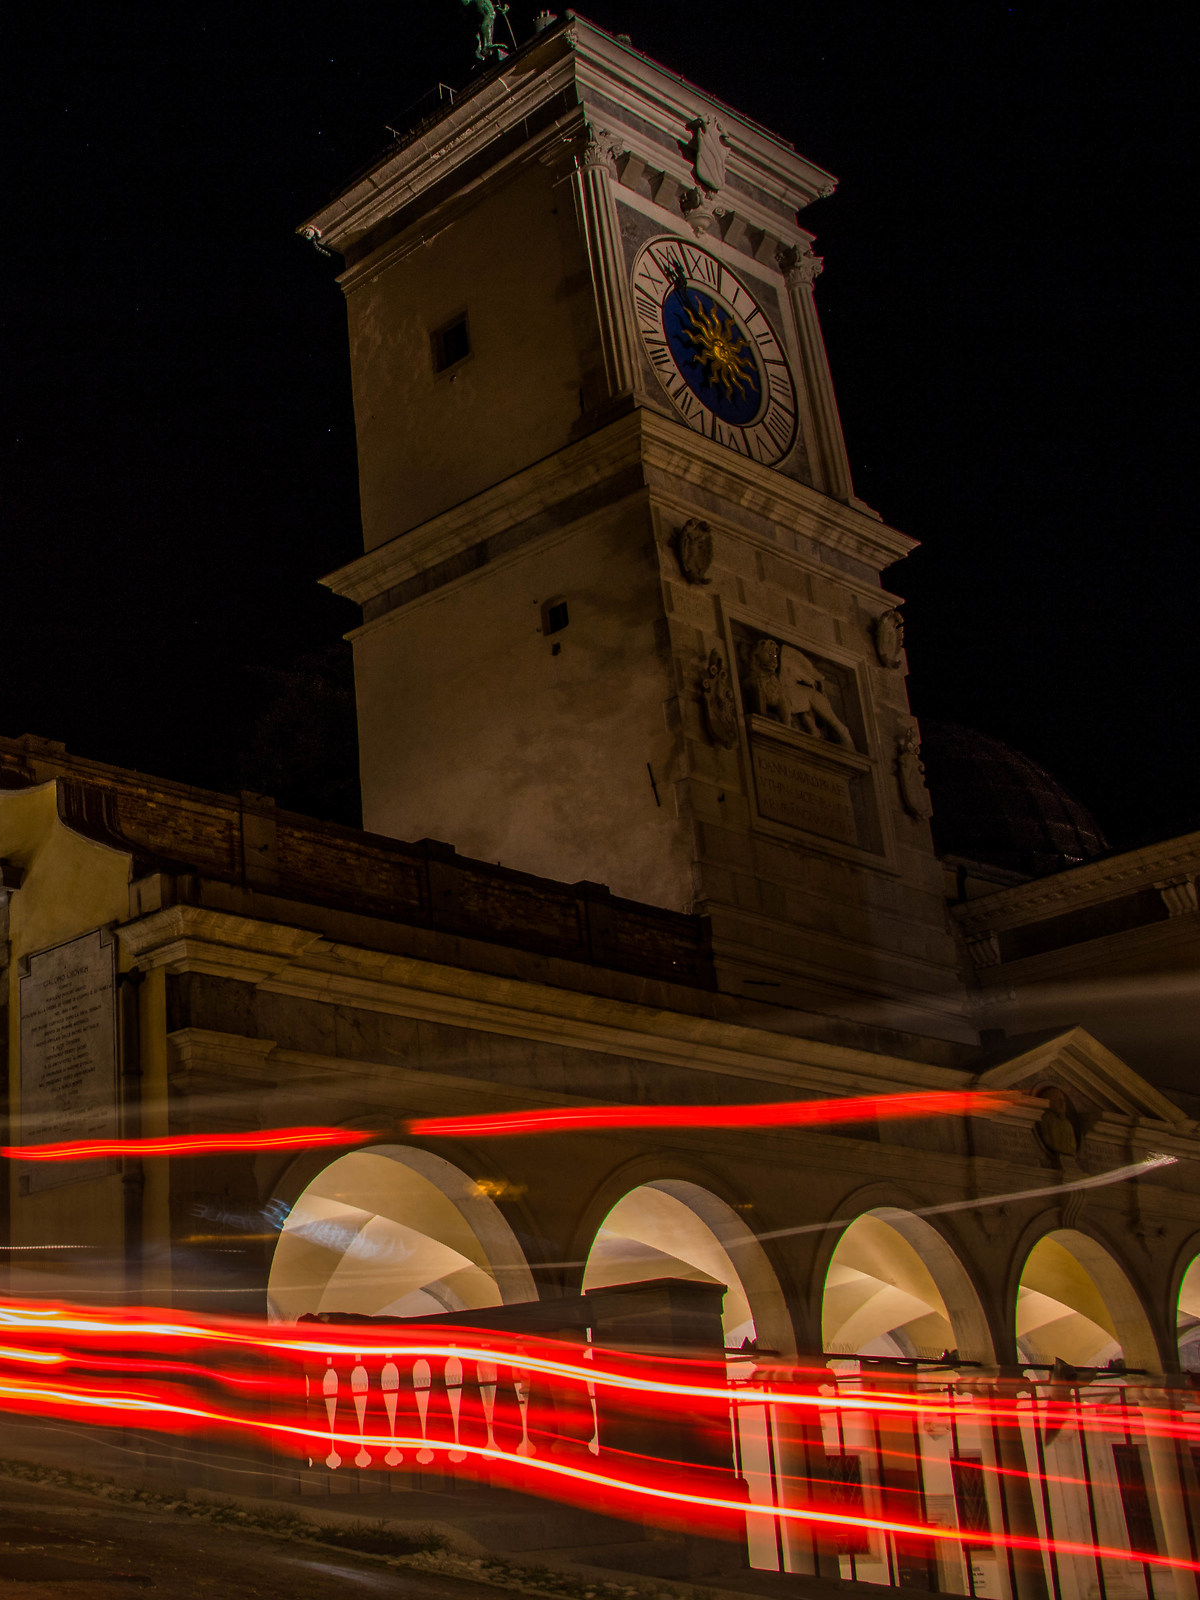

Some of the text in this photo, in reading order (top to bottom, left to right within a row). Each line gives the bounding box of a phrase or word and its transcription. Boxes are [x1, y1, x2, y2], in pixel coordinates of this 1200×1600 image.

[638, 261, 663, 295] X
[687, 248, 717, 287] XII
[732, 287, 740, 304] I
[755, 332, 772, 346] II
[770, 373, 791, 399] III
[753, 430, 775, 462] V
